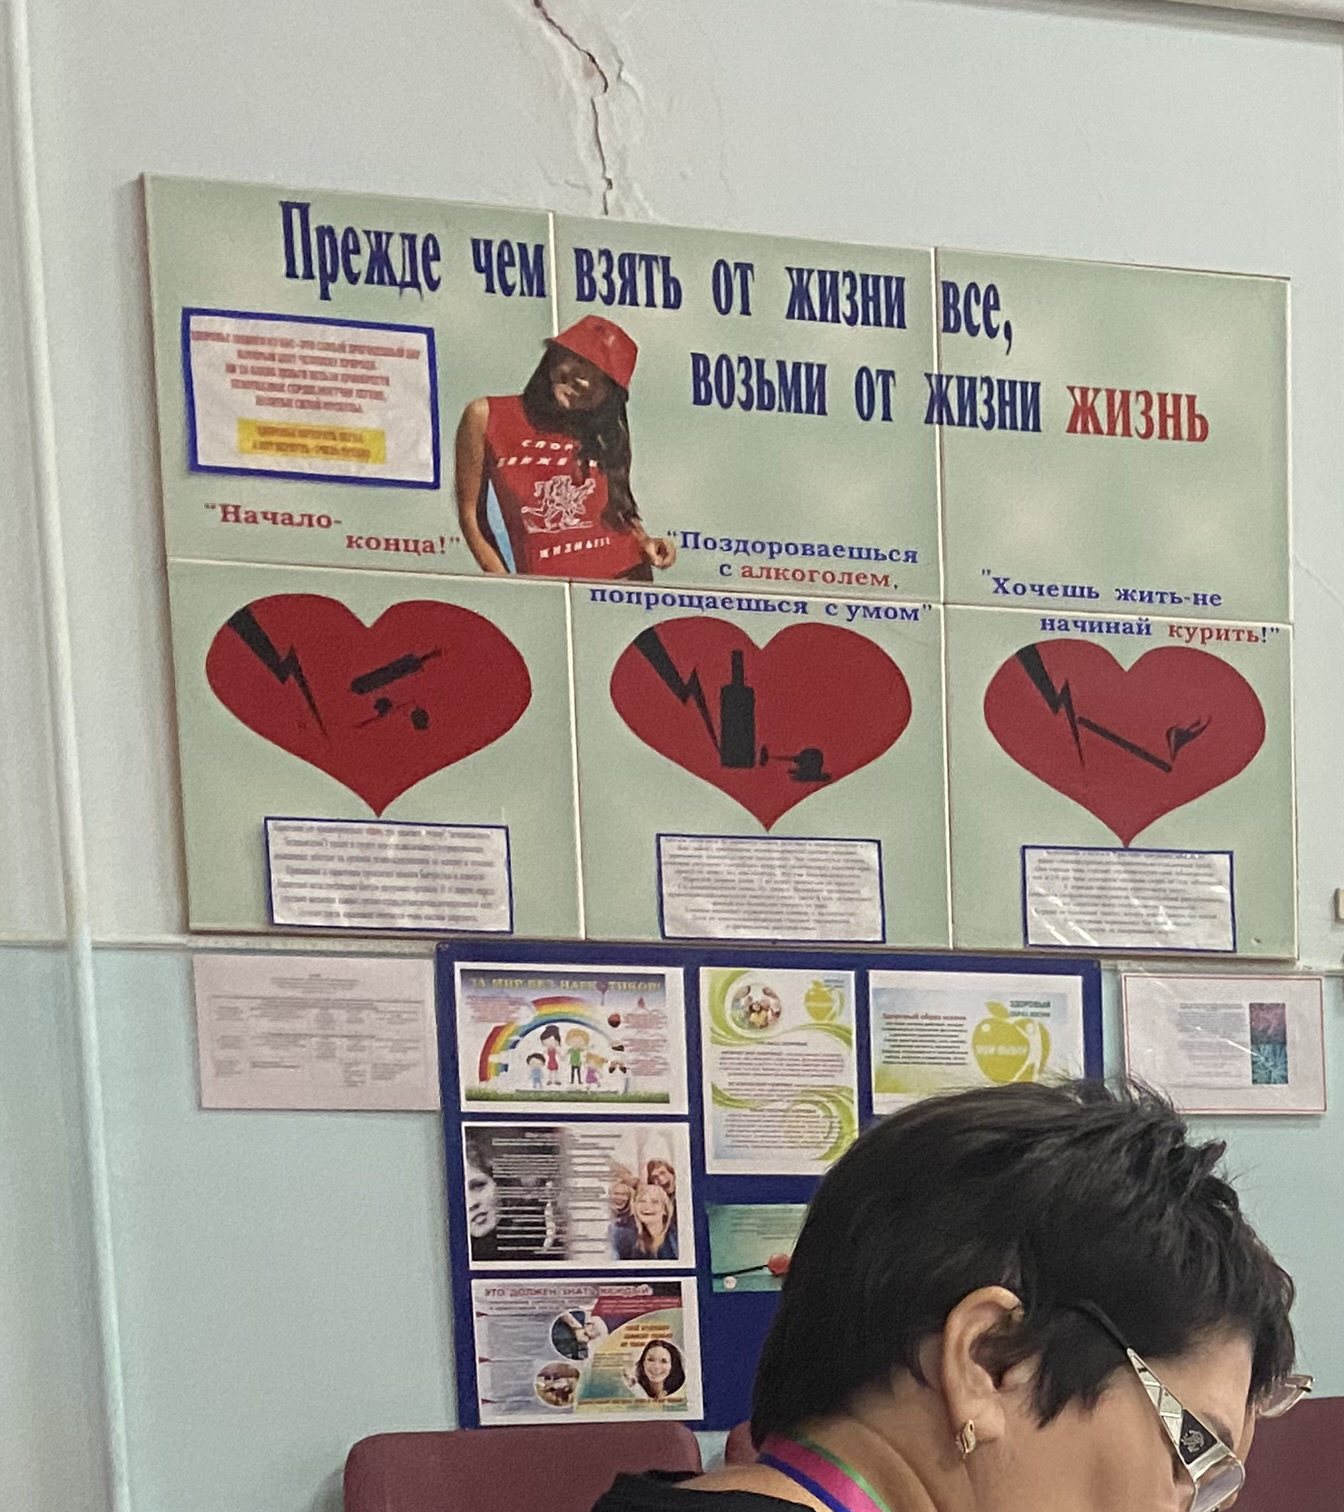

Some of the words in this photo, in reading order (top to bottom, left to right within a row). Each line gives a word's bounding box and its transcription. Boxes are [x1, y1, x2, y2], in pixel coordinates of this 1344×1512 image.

[280, 201, 441, 300] Прежде
[470, 238, 547, 299] чем
[573, 248, 683, 310] взять
[711, 259, 755, 317] от
[784, 267, 907, 330] жизни
[940, 277, 1013, 355] все,
[690, 352, 828, 418] возьми
[854, 365, 898, 422] от
[923, 372, 1042, 434] жизни
[720, 562, 733, 578] с
[590, 588, 808, 616] попрощаешься
[825, 604, 840, 619] с
[1040, 616, 1153, 637] начинай
